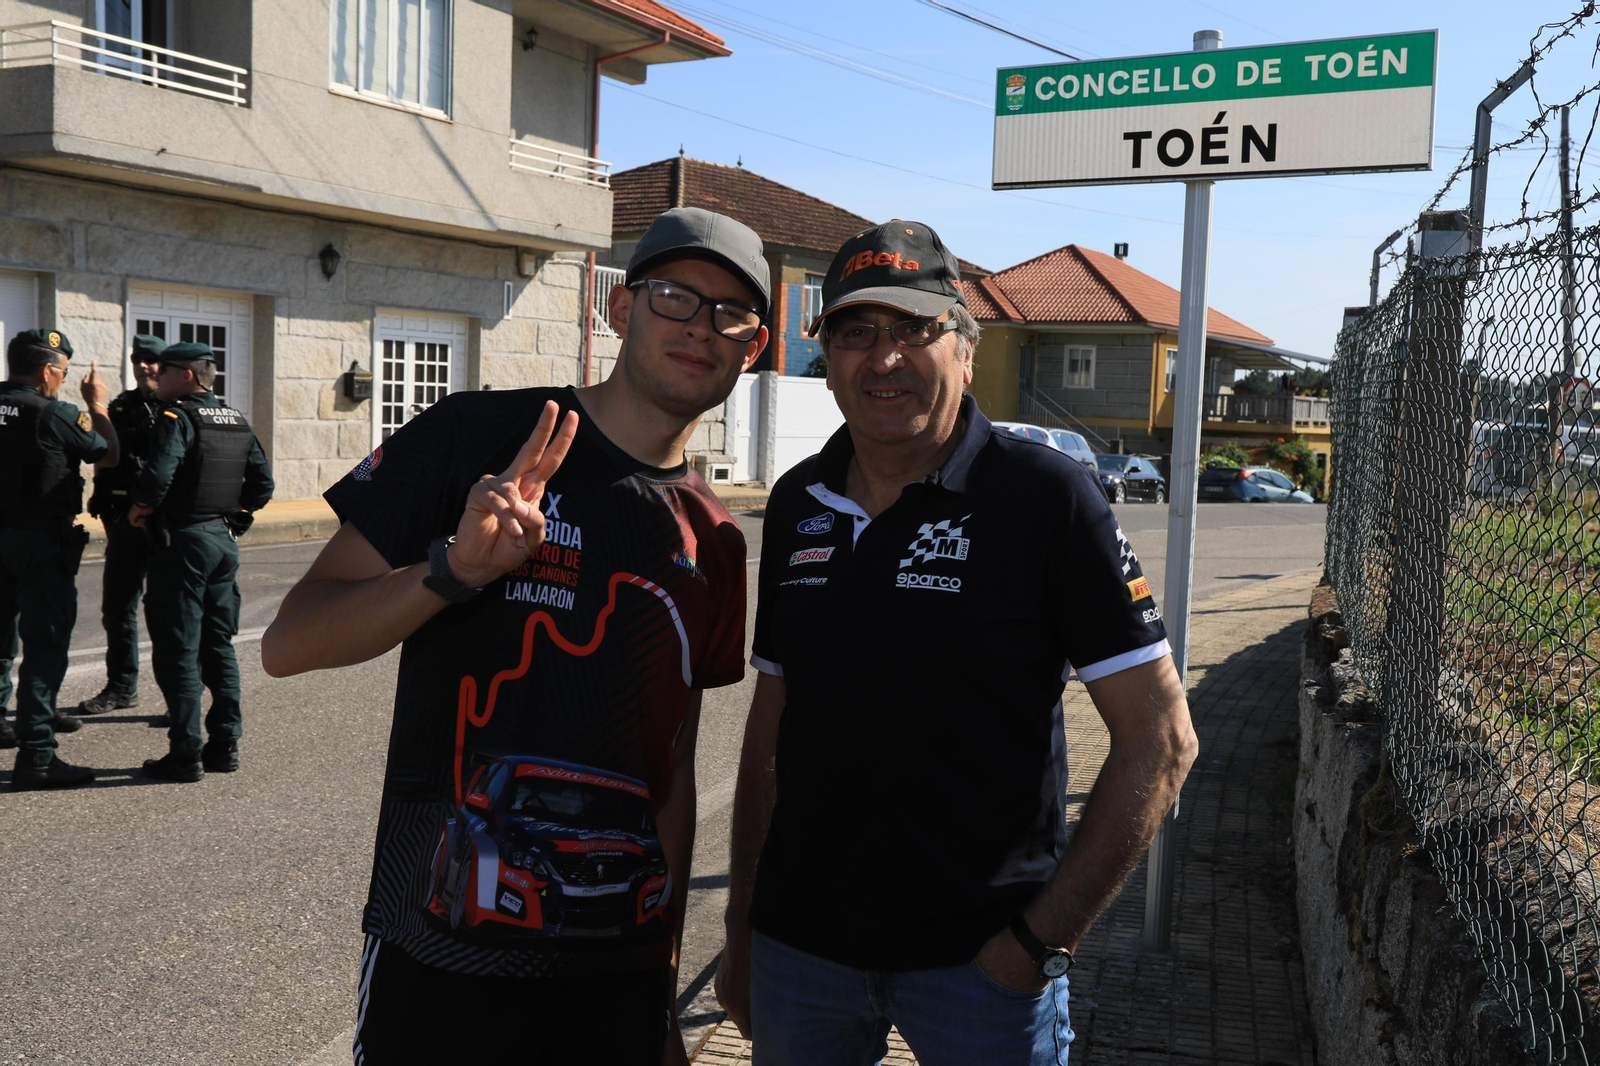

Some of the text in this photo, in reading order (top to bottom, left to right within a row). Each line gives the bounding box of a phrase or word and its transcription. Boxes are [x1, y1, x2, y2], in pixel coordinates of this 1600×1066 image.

[1034, 44, 1409, 101] CONCELLO DE TOÉN
[1122, 111, 1278, 169] TOÉN
[854, 250, 920, 272] Beta
[0, 405, 19, 417] DIA
[198, 407, 242, 417] GUARDIA
[212, 415, 238, 425] CIVIL
[544, 519, 582, 550] BIDA
[531, 543, 582, 570] RRO DE
[796, 549, 831, 562] Castrol
[936, 538, 960, 557] M
[960, 539, 969, 559] SPORT
[531, 563, 579, 587] CAÑONES
[896, 572, 962, 590] sparco
[505, 580, 576, 611] LANJARÓN
[504, 895, 521, 907] VICO
